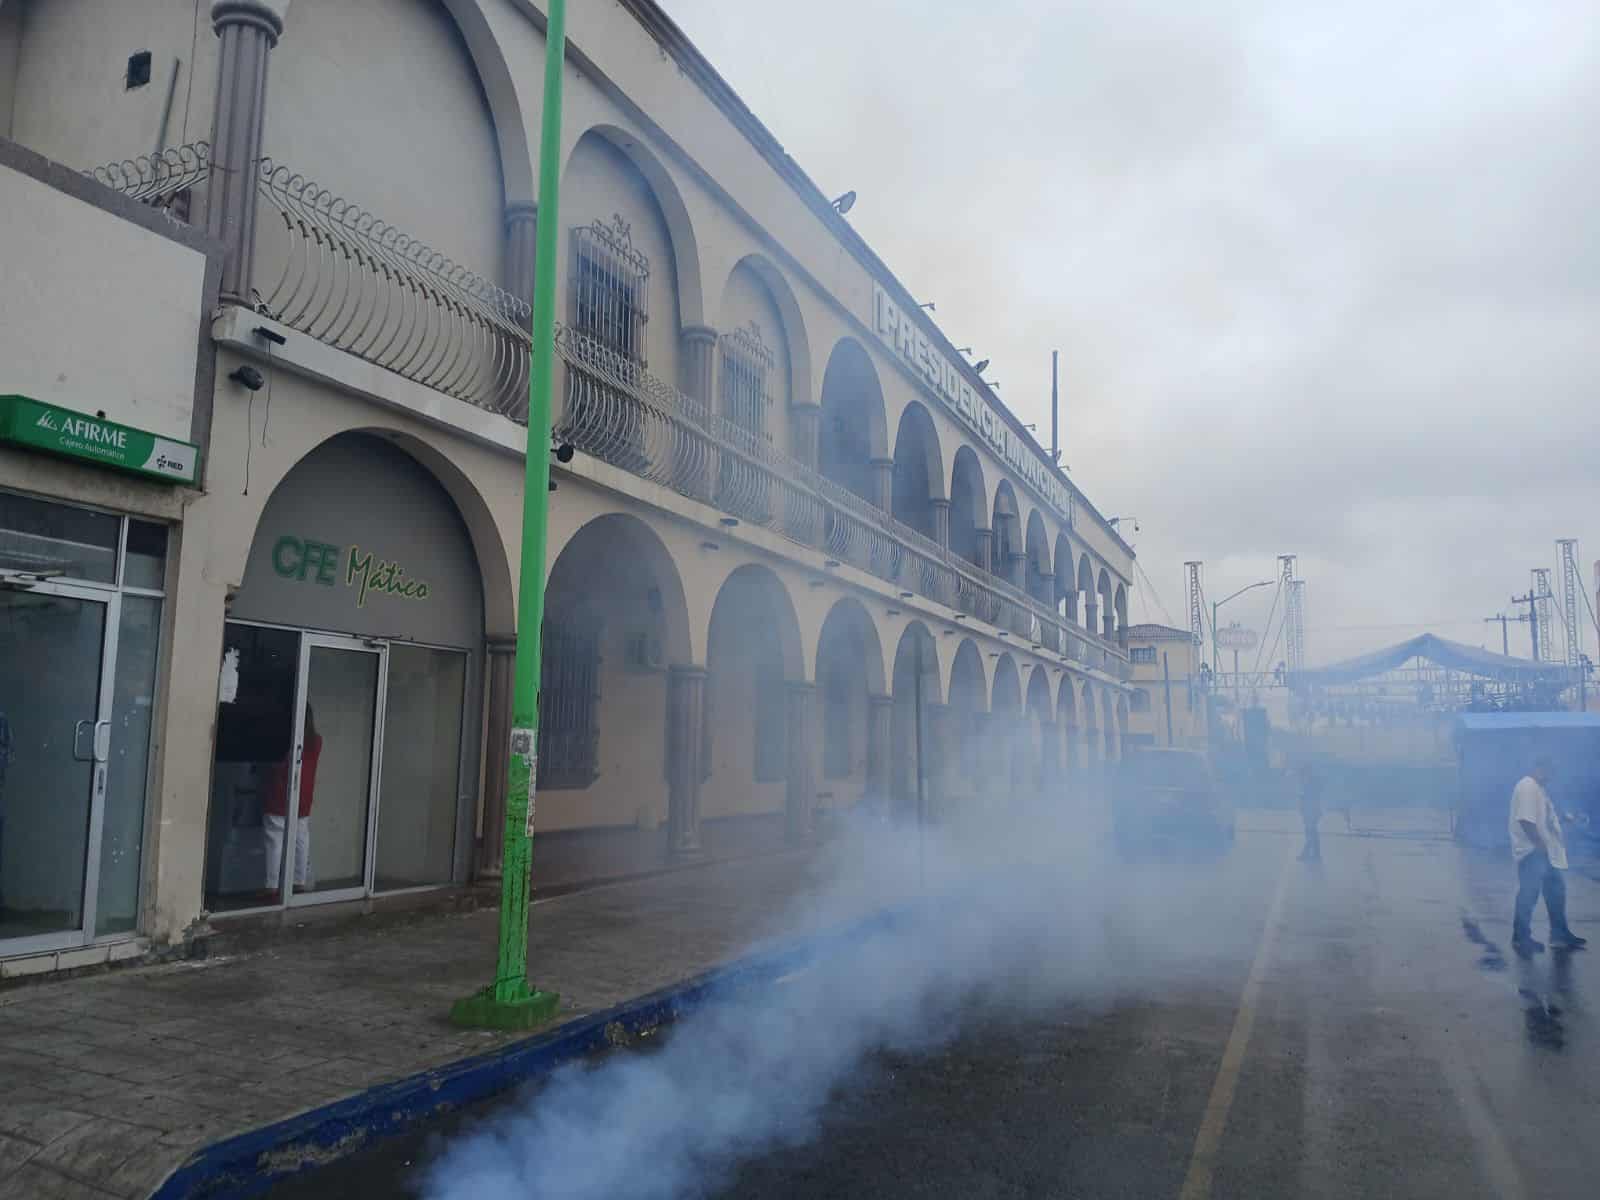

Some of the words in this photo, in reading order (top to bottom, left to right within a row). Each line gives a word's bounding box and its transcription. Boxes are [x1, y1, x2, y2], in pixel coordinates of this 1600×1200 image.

[880, 286, 1005, 455] PRESIDENCIA
[59, 436, 85, 449] Cajero
[61, 417, 127, 448] AFIRME
[272, 535, 339, 587] CFE
[346, 545, 430, 608] Mático
